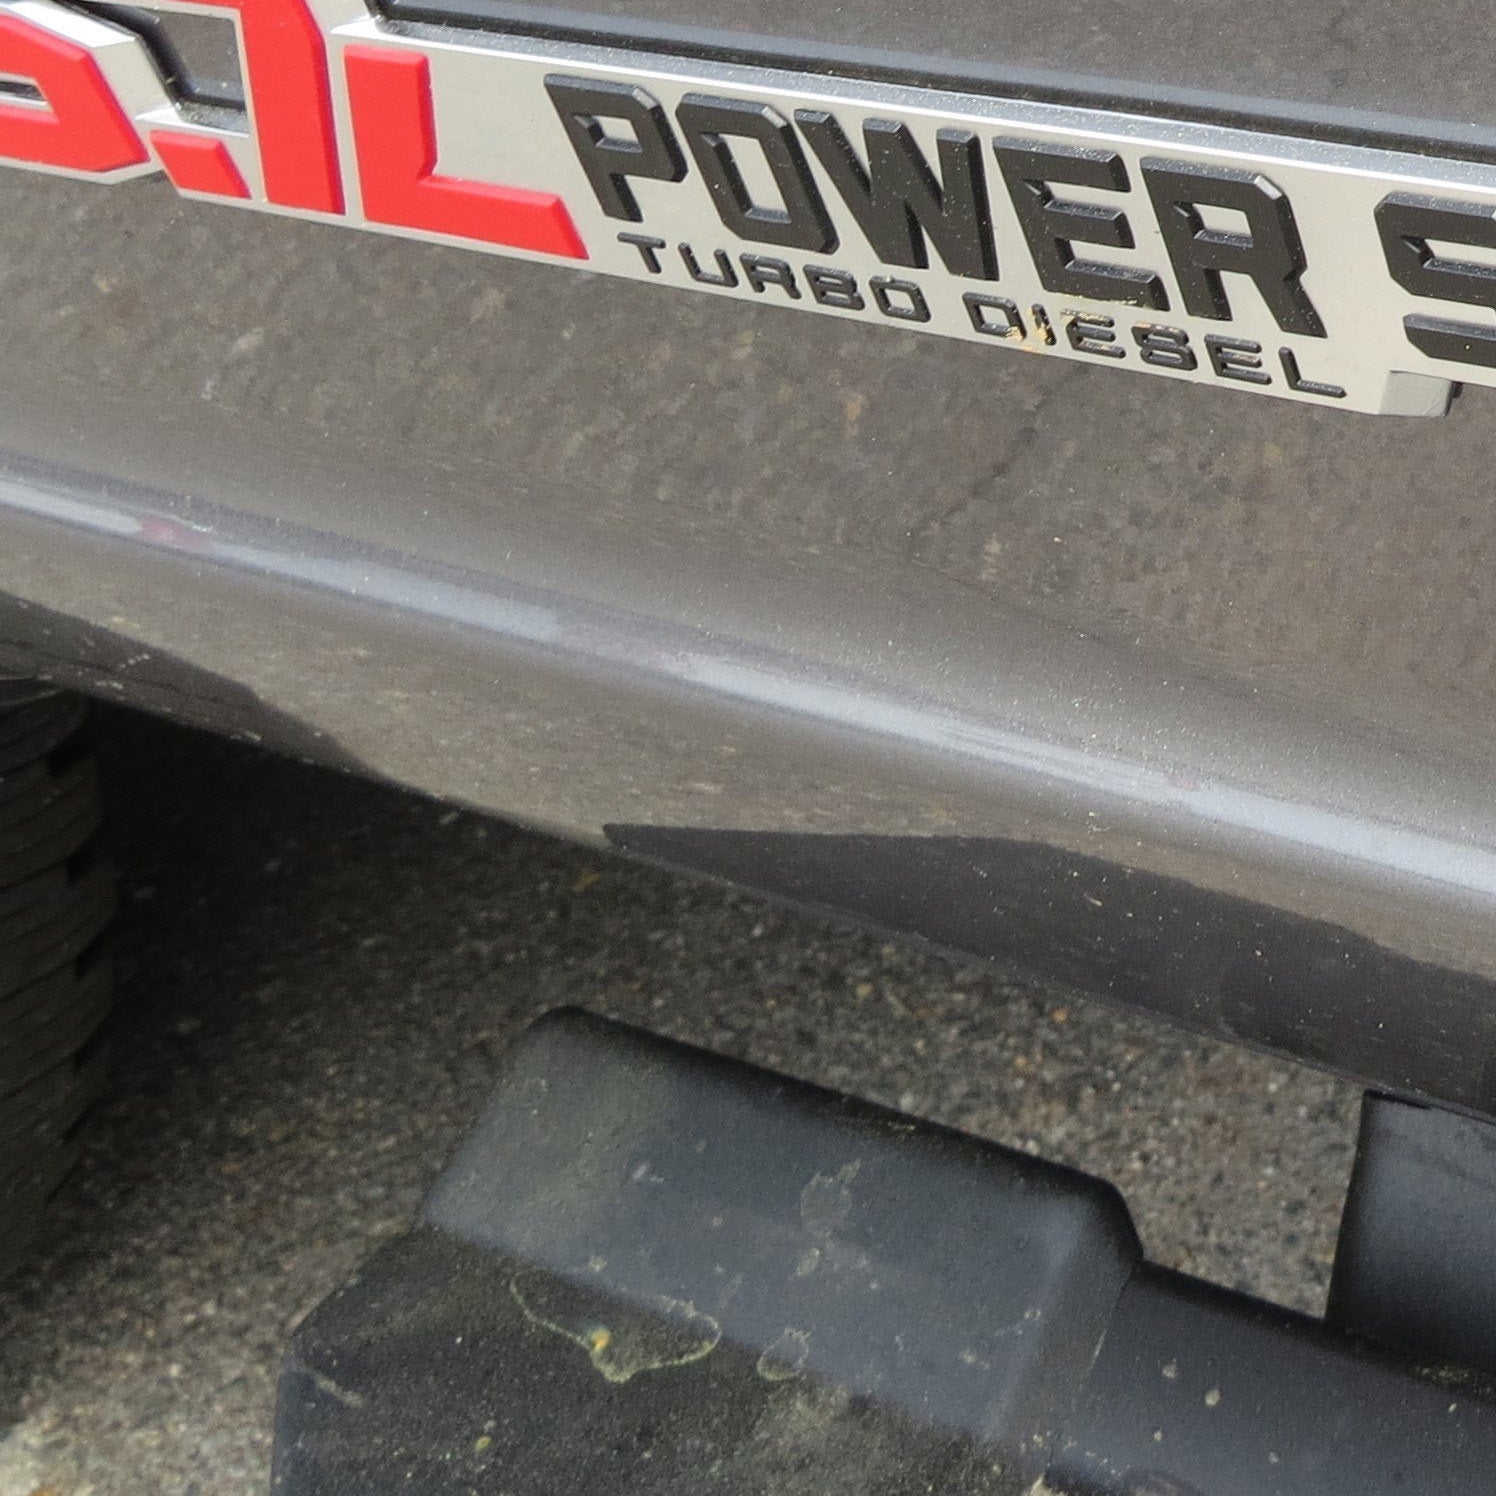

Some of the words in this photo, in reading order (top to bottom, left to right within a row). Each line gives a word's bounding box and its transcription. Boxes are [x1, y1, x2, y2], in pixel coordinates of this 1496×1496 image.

[544, 73, 1327, 338] POWER
[616, 231, 931, 324] TURBO
[963, 291, 1347, 398] DIESEL
